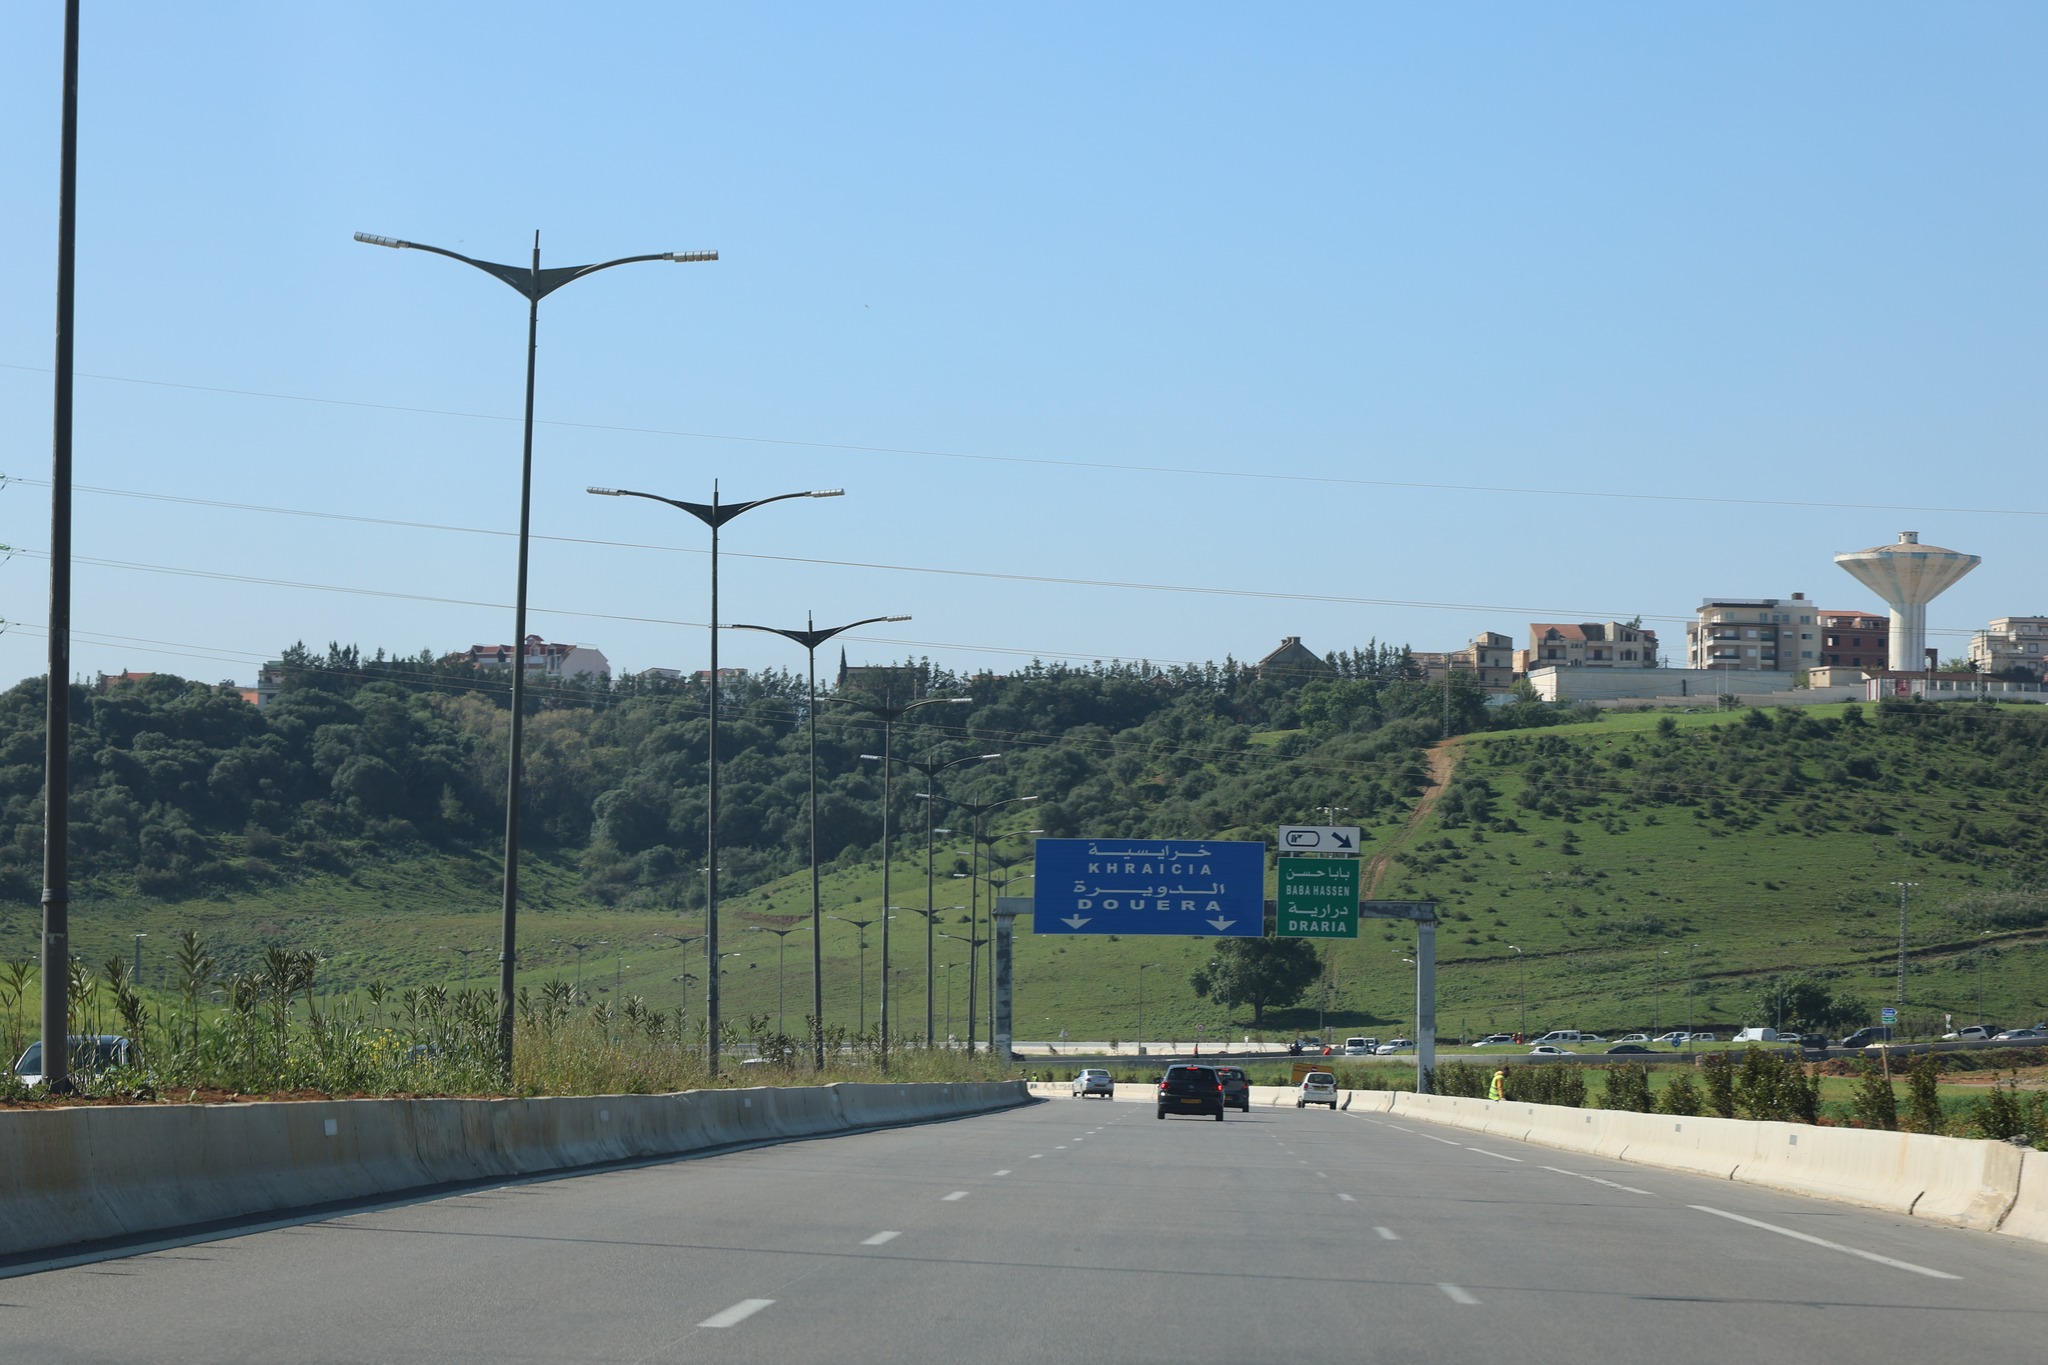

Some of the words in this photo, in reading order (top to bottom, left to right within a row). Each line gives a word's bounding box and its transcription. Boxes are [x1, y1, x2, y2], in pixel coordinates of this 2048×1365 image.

[1088, 843, 1211, 860] خرايسية
[1088, 862, 1212, 875] KHRAICIA
[1286, 868, 1325, 880] حسن
[1328, 866, 1349, 880] بابا
[1073, 880, 1226, 898] الدويرة
[1286, 884, 1310, 895] BABA
[1313, 885, 1349, 896] HASSEN
[1077, 899, 1221, 912] DOUERA
[1288, 901, 1348, 918] درارية
[1288, 920, 1346, 932] DRARIA
